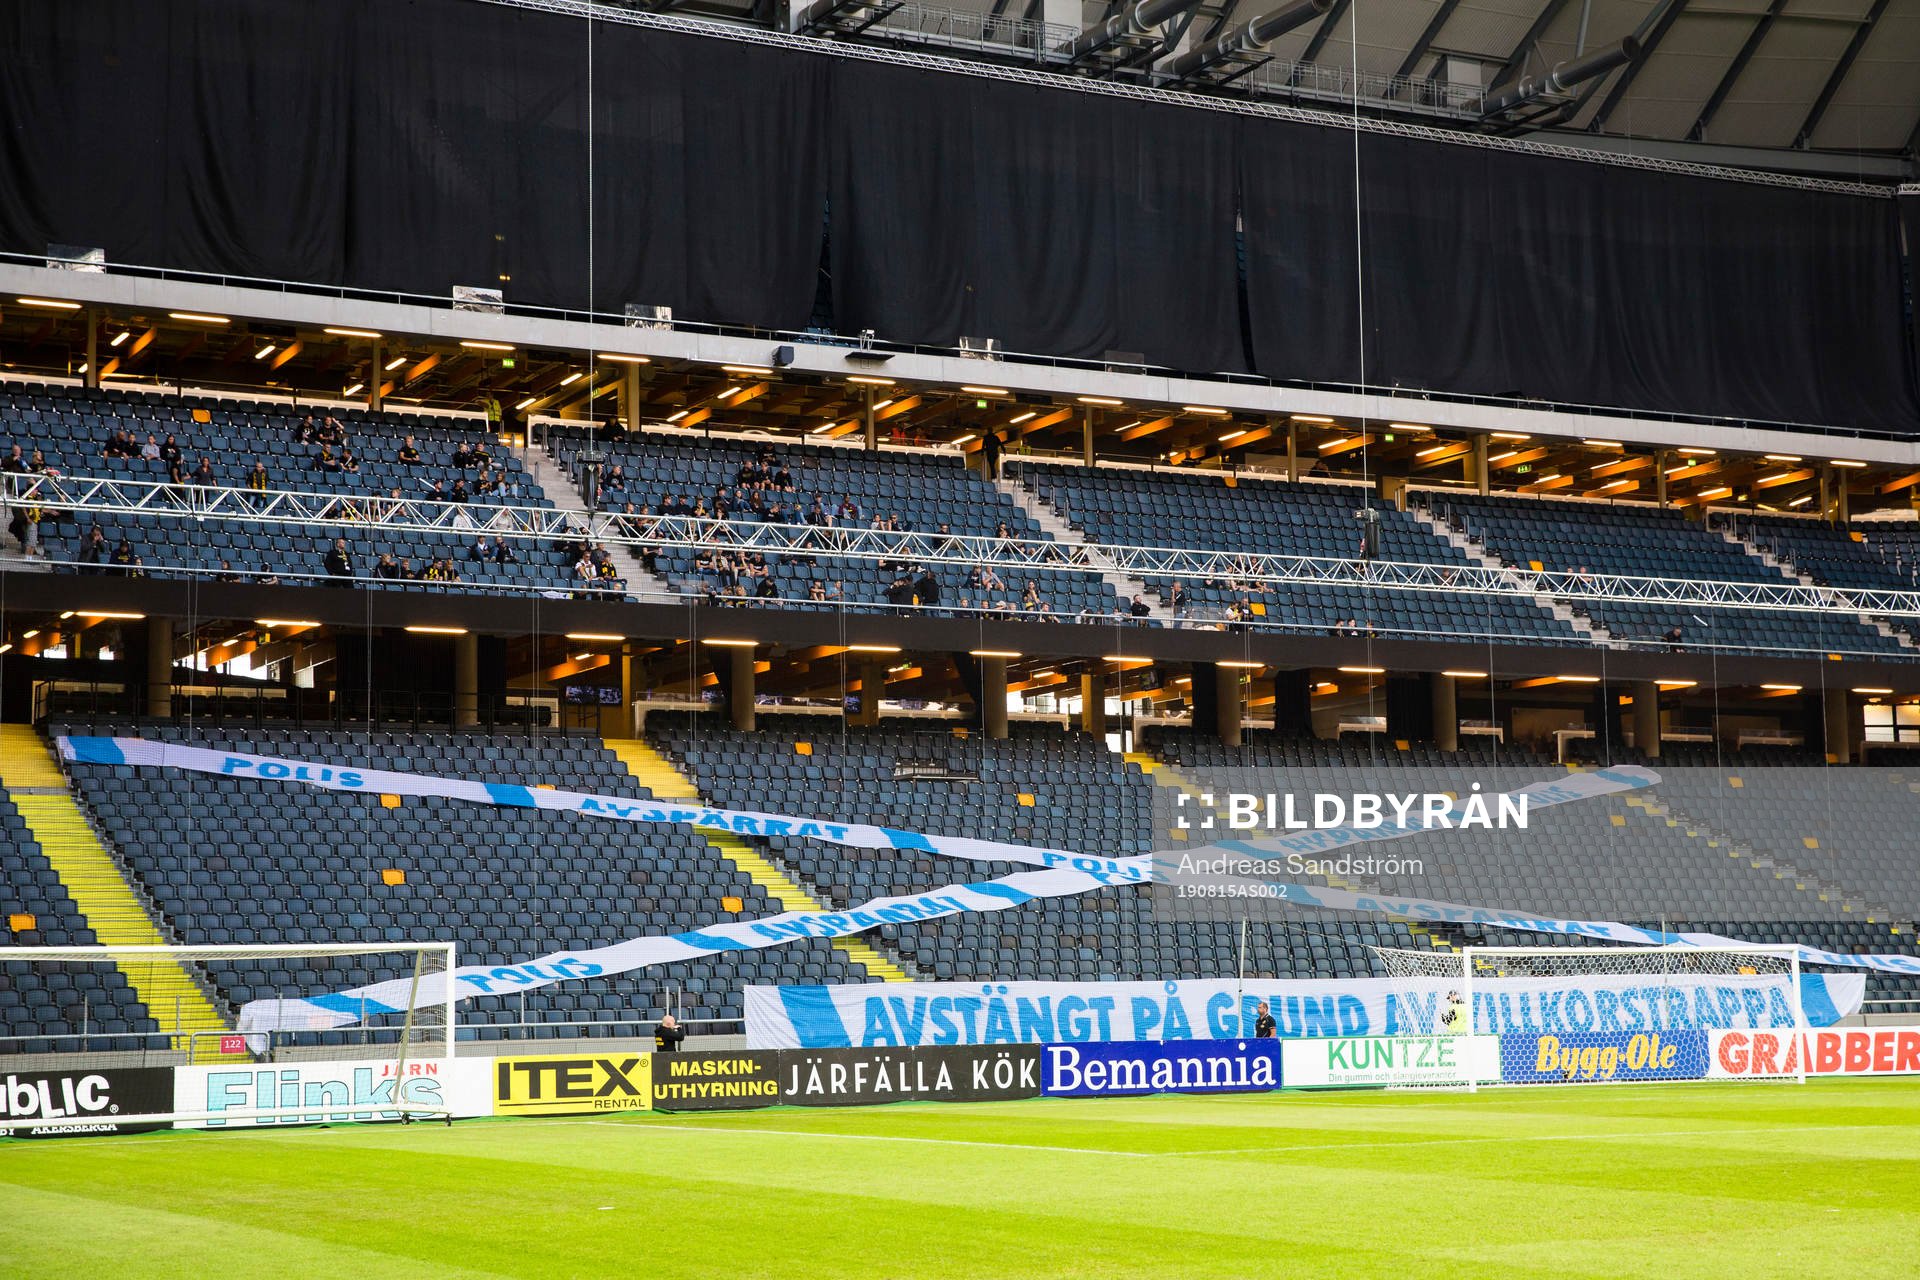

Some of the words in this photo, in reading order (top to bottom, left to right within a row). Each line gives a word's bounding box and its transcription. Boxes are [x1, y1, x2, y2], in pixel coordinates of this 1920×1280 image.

[223, 757, 364, 787] POLIS
[456, 957, 604, 993] POLIS
[862, 984, 1116, 1046] AVSTÄNGT
[1130, 980, 1193, 1041] PÅ
[225, 1039, 241, 1049] 122
[1327, 1038, 1456, 1070] KUNTZE
[498, 1058, 641, 1101] ITEX
[670, 1059, 762, 1077] MASKIN-
[785, 1056, 953, 1096] JÄRFÄLLA
[973, 1052, 1037, 1090] KÖK
[1048, 1042, 1276, 1091] Bemannia
[207, 1068, 444, 1125] Flinks
[594, 1099, 645, 1109] RENTAL
[654, 1080, 778, 1100] UTHYRNING
